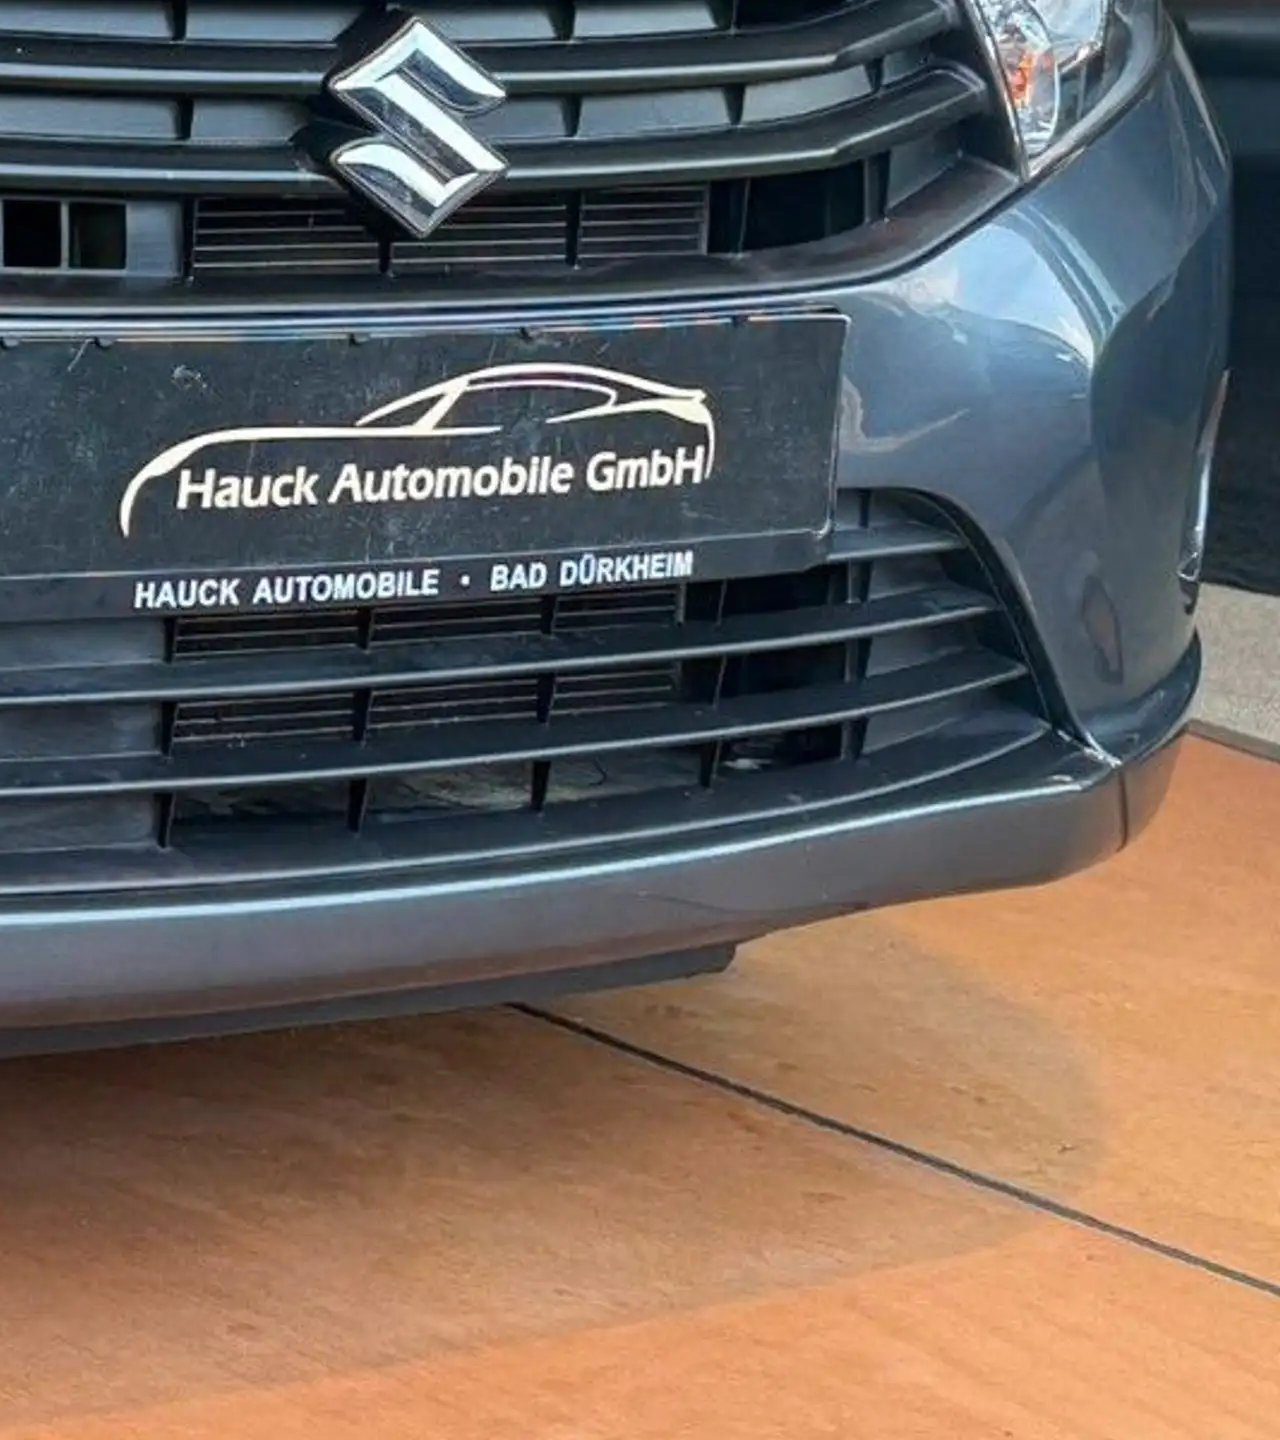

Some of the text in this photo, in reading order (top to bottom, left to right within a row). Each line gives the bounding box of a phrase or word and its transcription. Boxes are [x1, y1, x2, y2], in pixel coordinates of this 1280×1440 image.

[176, 444, 706, 510] Hauck Automobile GmbH
[134, 549, 694, 609] HAUCK AUTOMOBILE BAD DÜRKHEIM
